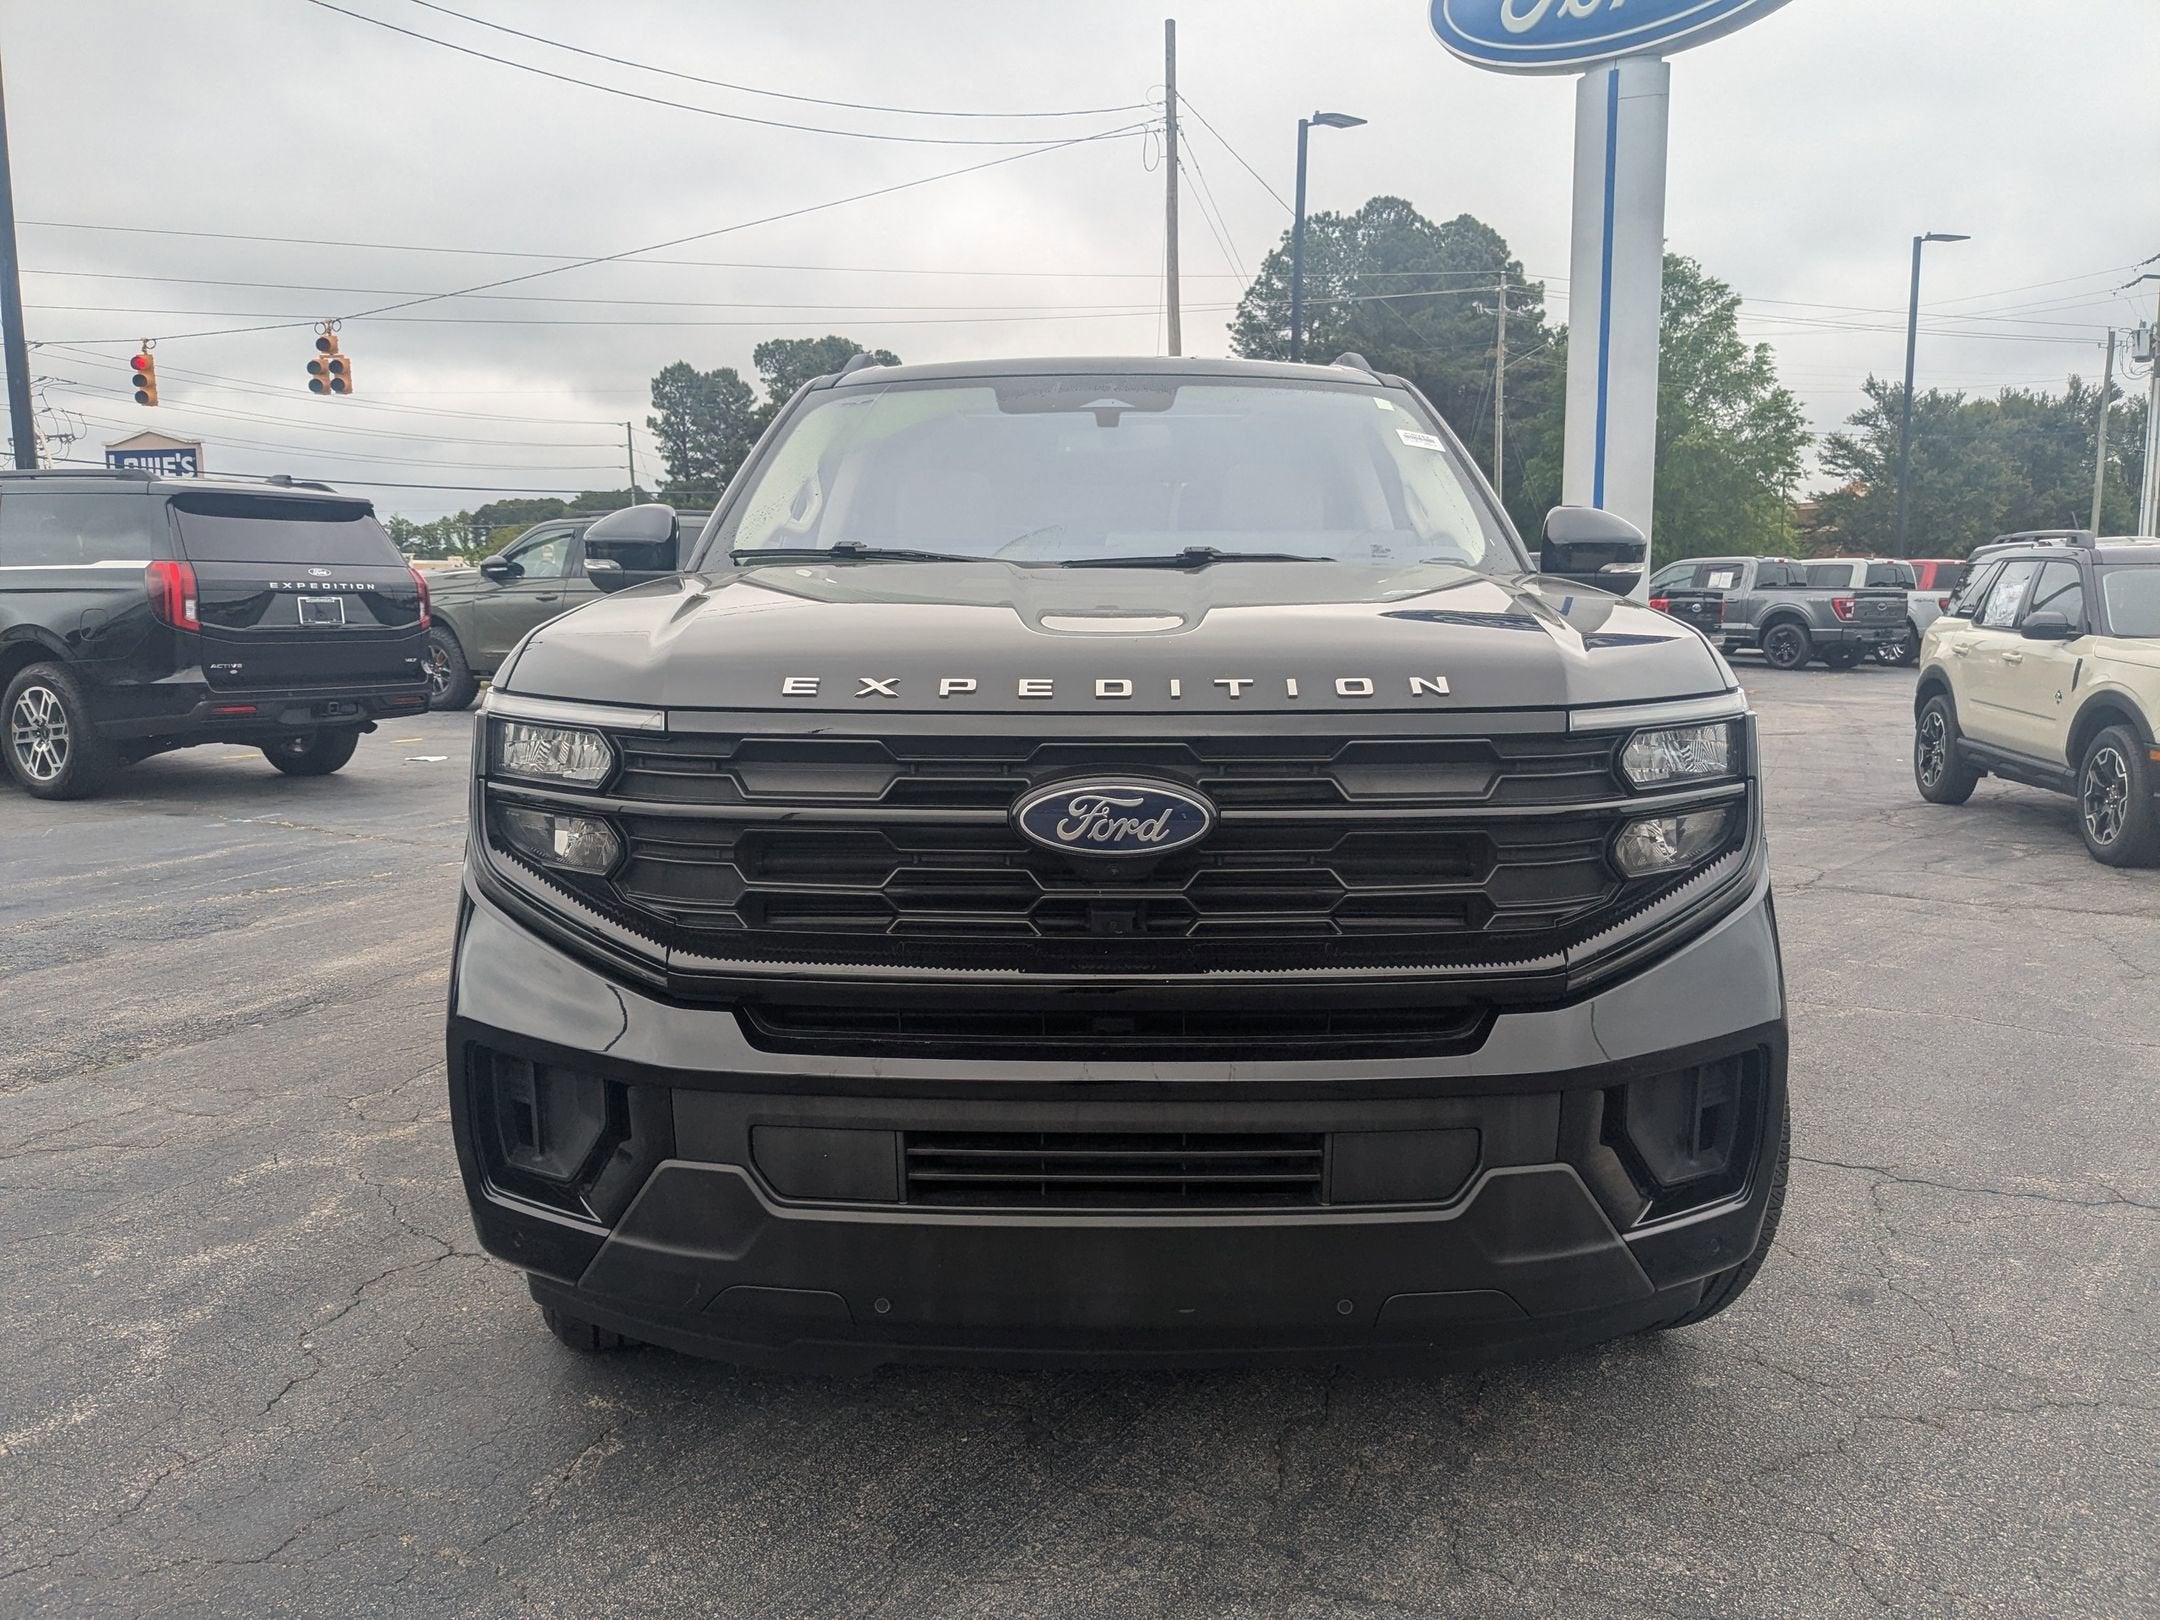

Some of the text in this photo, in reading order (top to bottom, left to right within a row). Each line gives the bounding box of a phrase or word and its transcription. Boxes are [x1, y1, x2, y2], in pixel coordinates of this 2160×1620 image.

[269, 582, 375, 590] EXPEDITION
[782, 675, 1450, 698] EXPEDITION
[1056, 795, 1173, 842] Ford
